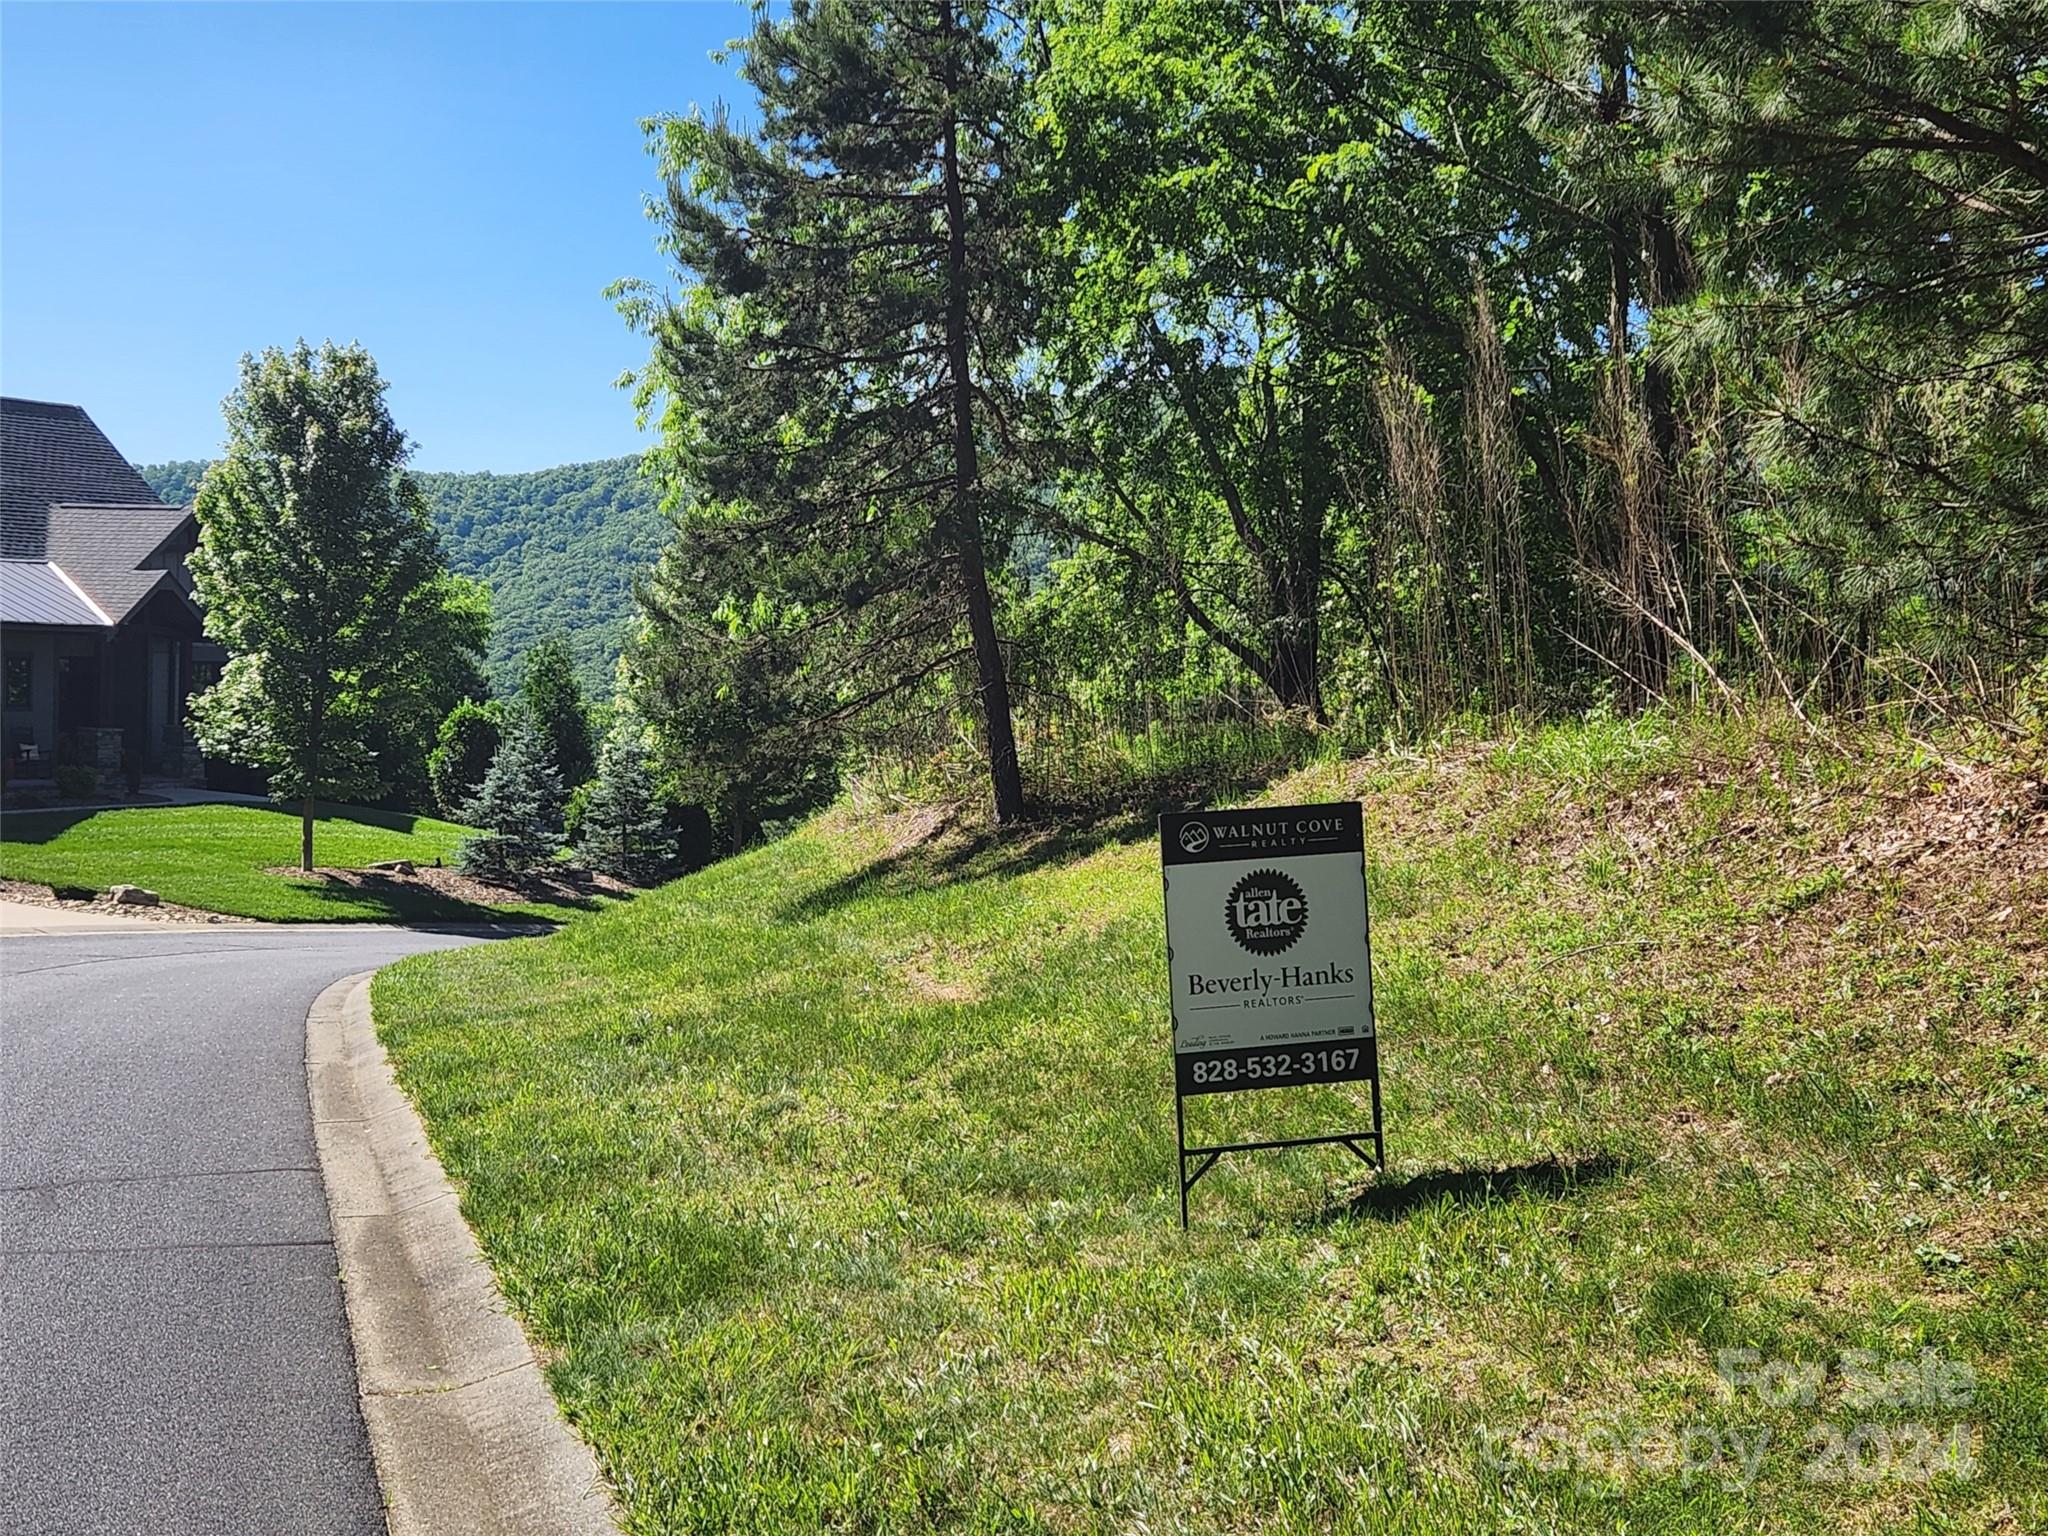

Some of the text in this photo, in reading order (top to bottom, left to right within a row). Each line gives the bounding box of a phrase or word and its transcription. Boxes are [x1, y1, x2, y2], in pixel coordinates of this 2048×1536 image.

[1213, 818, 1344, 839] WALNUT COVE
[1252, 837, 1308, 848] REALTY
[1245, 887, 1271, 899] allen
[1232, 889, 1302, 928] tate
[1188, 962, 1354, 996] Beverly-Hanks
[1243, 996, 1302, 1009] REALTORS
[1193, 1048, 1360, 1084] 828-532-3167
